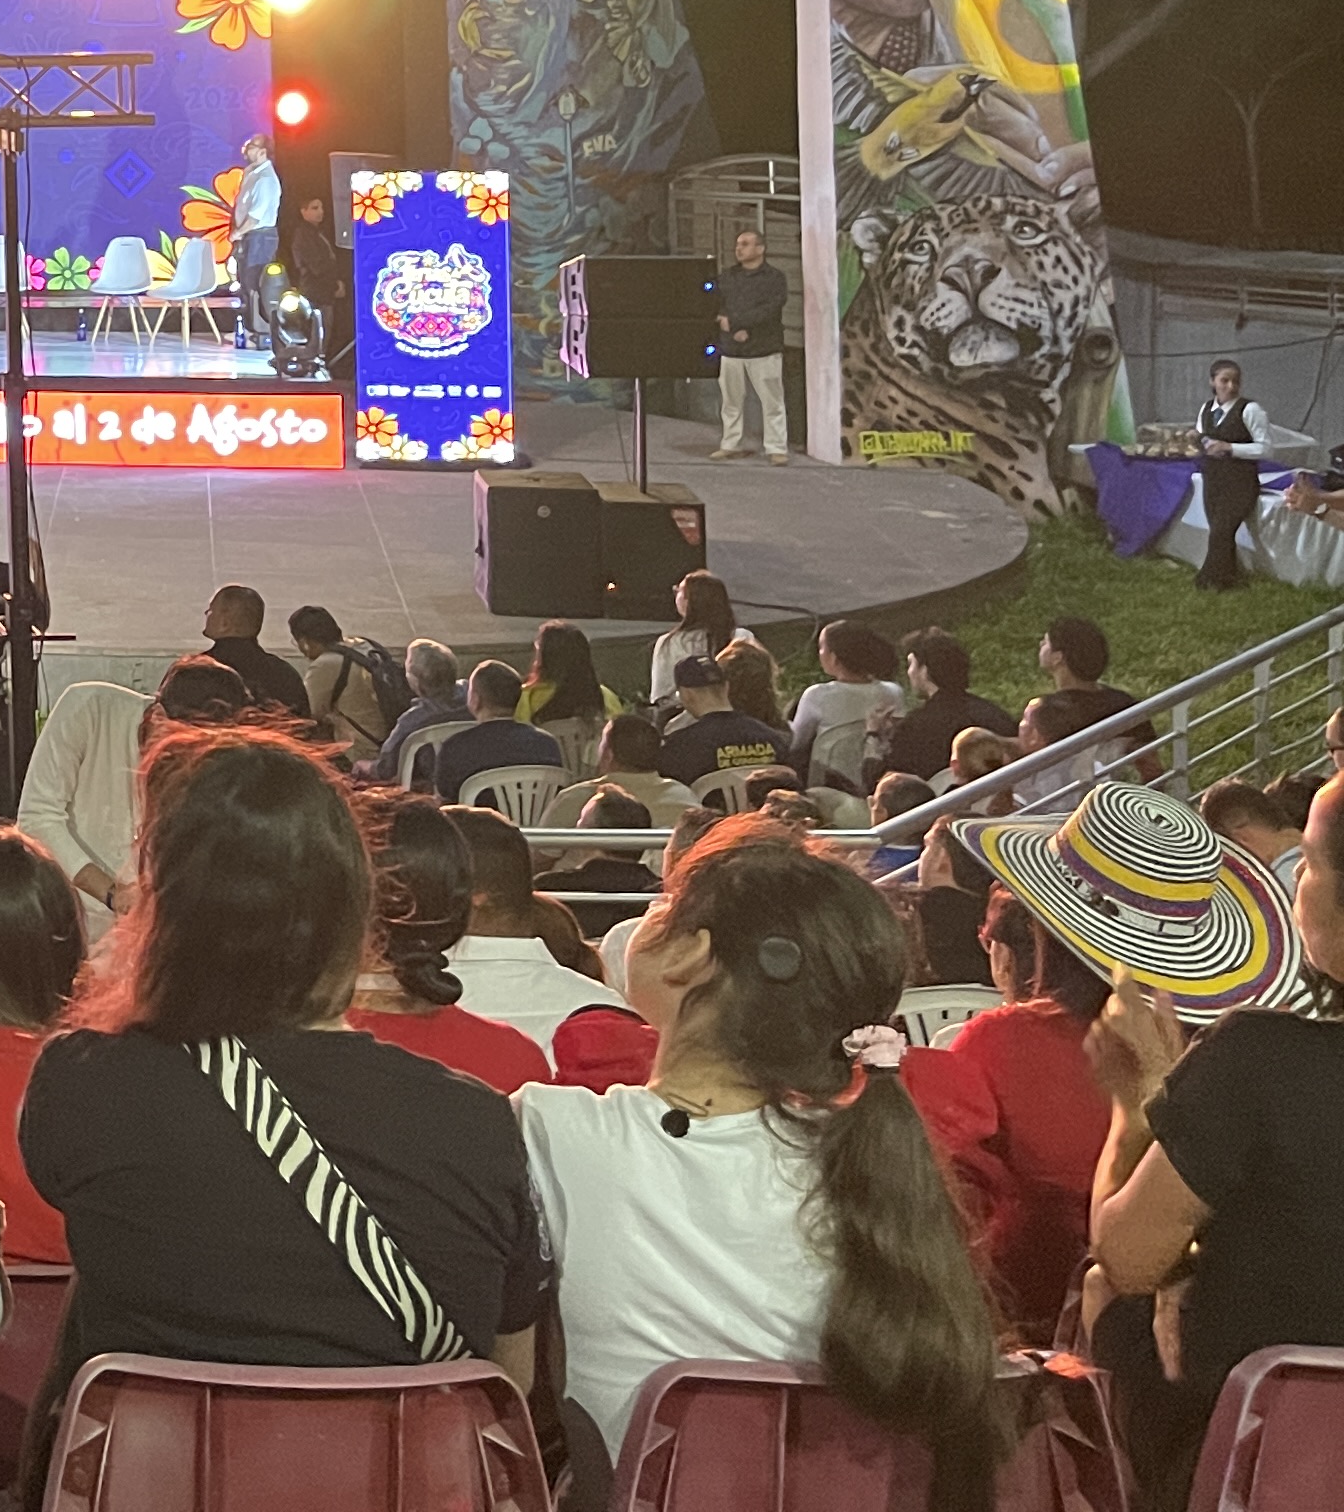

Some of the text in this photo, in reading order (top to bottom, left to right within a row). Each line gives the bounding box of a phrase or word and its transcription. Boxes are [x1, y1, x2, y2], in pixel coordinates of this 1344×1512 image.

[51, 402, 87, 445] al
[97, 410, 123, 442] 2
[130, 404, 177, 445] de
[185, 402, 328, 456] Agosto
[716, 742, 776, 759] ARMADA
